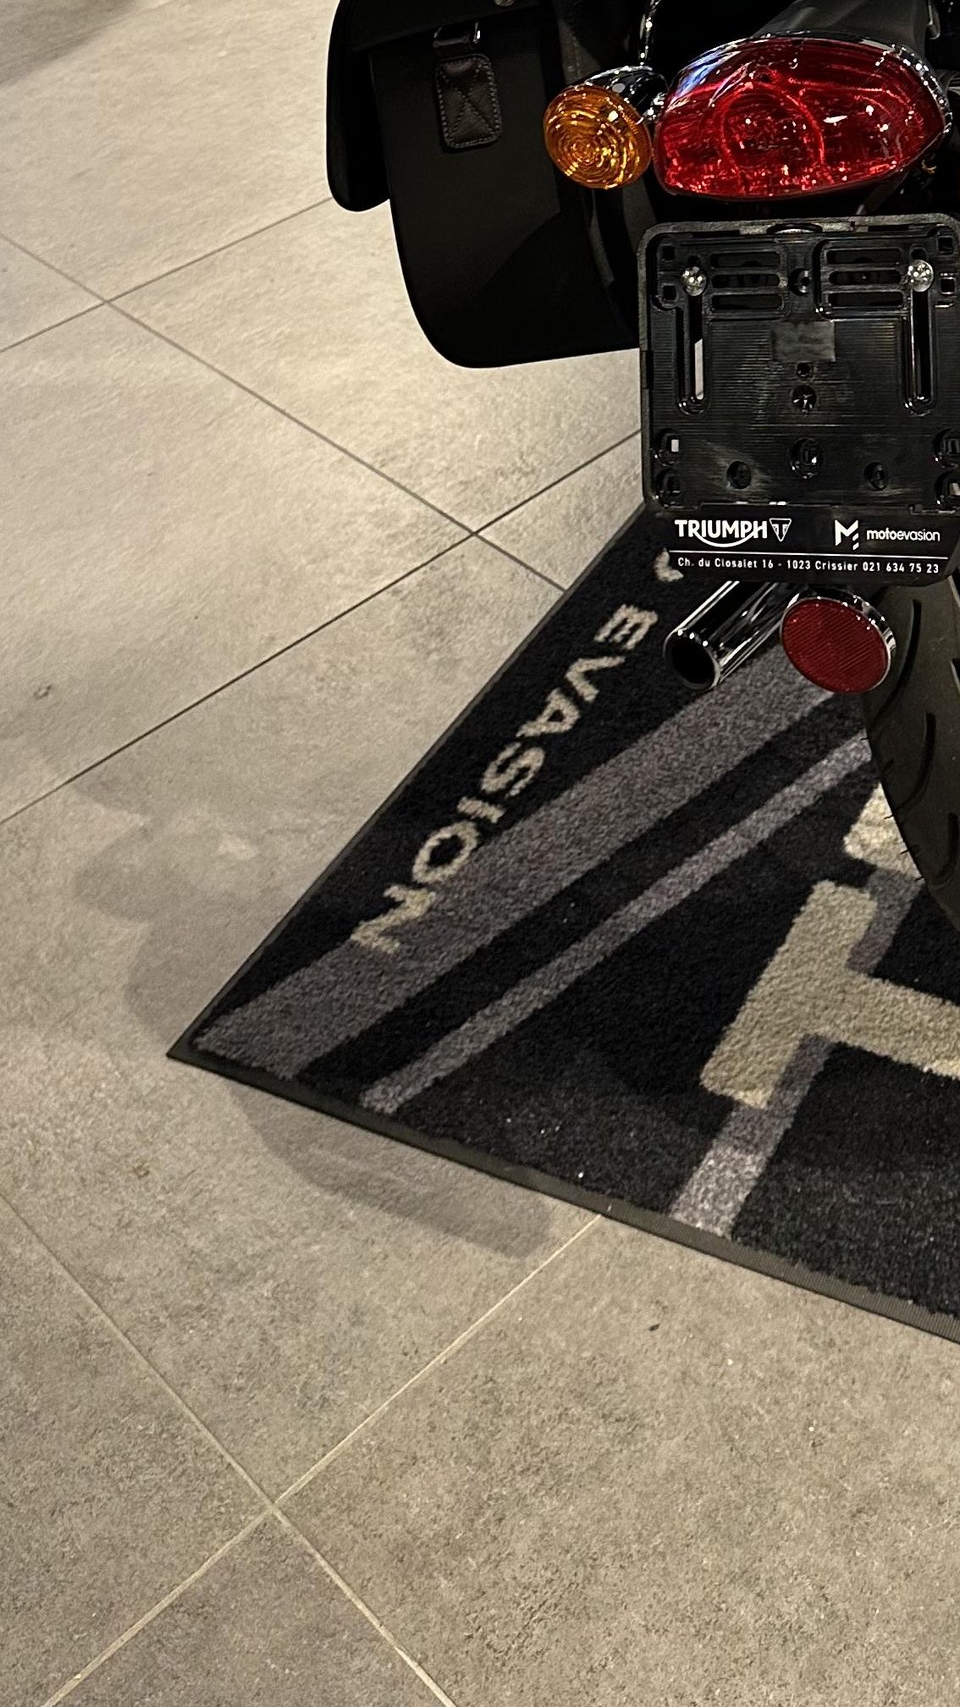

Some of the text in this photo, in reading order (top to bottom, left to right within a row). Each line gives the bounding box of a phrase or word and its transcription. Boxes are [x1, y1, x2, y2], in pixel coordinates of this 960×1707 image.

[674, 519, 768, 548] TRIUMPH
[866, 527, 941, 542] motoevasion
[677, 557, 695, 567] Ch.
[698, 558, 711, 567] du
[714, 557, 758, 568] Closalet
[762, 559, 774, 569] 16
[786, 559, 811, 570] 1023
[814, 560, 858, 571] Crissier
[862, 561, 881, 572] 021
[885, 562, 905, 573] 634
[909, 563, 922, 573] 75
[926, 563, 939, 574] 23
[350, 603, 660, 954] EVASION
